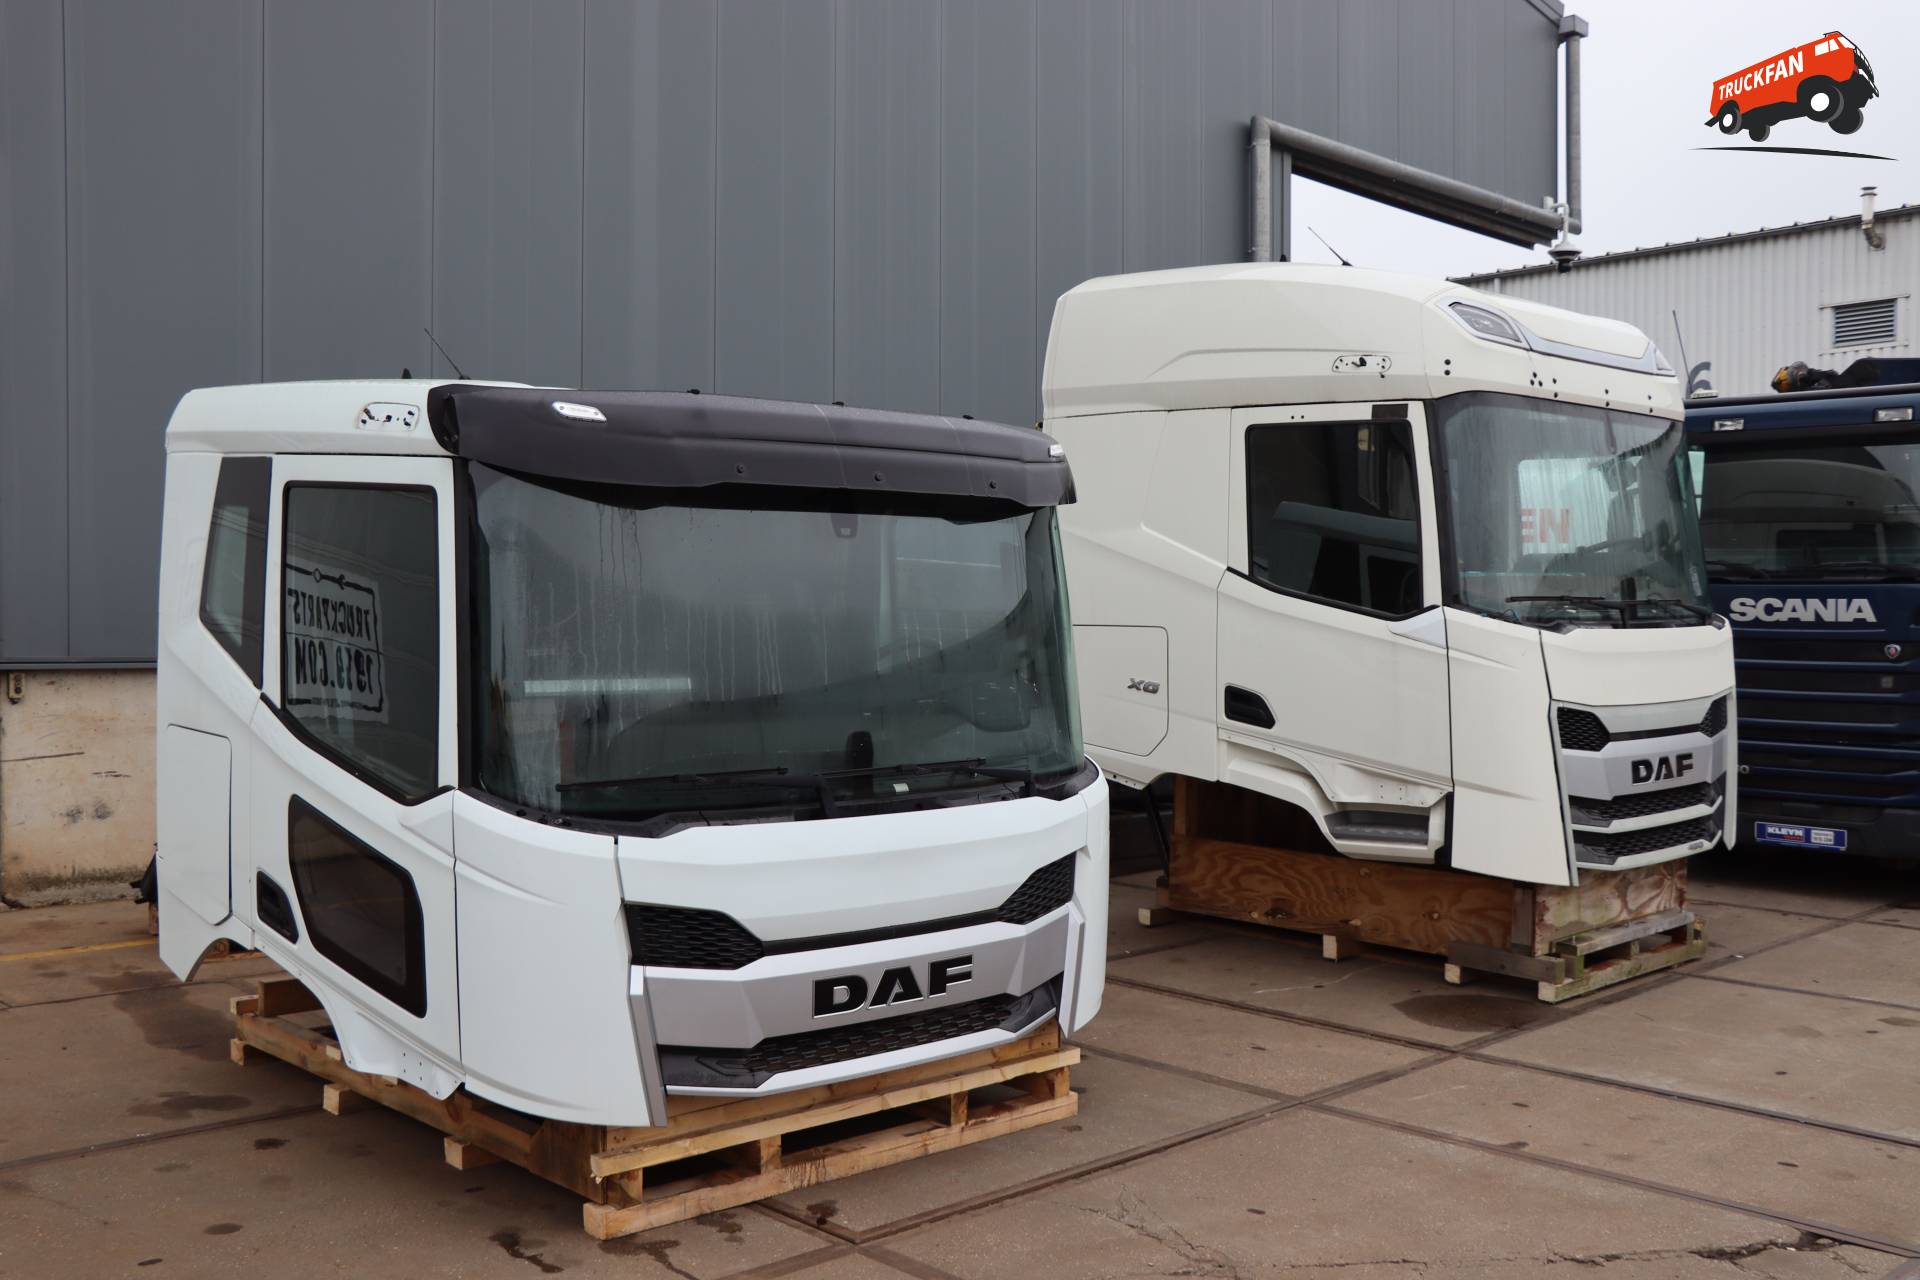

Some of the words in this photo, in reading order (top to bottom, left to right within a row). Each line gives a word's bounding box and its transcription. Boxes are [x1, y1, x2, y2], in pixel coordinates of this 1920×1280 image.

[1729, 597, 1878, 622] SCANIA
[1631, 752, 1694, 785] DAF
[1767, 826, 1803, 837] KLEYN
[812, 954, 974, 1018] DAF
